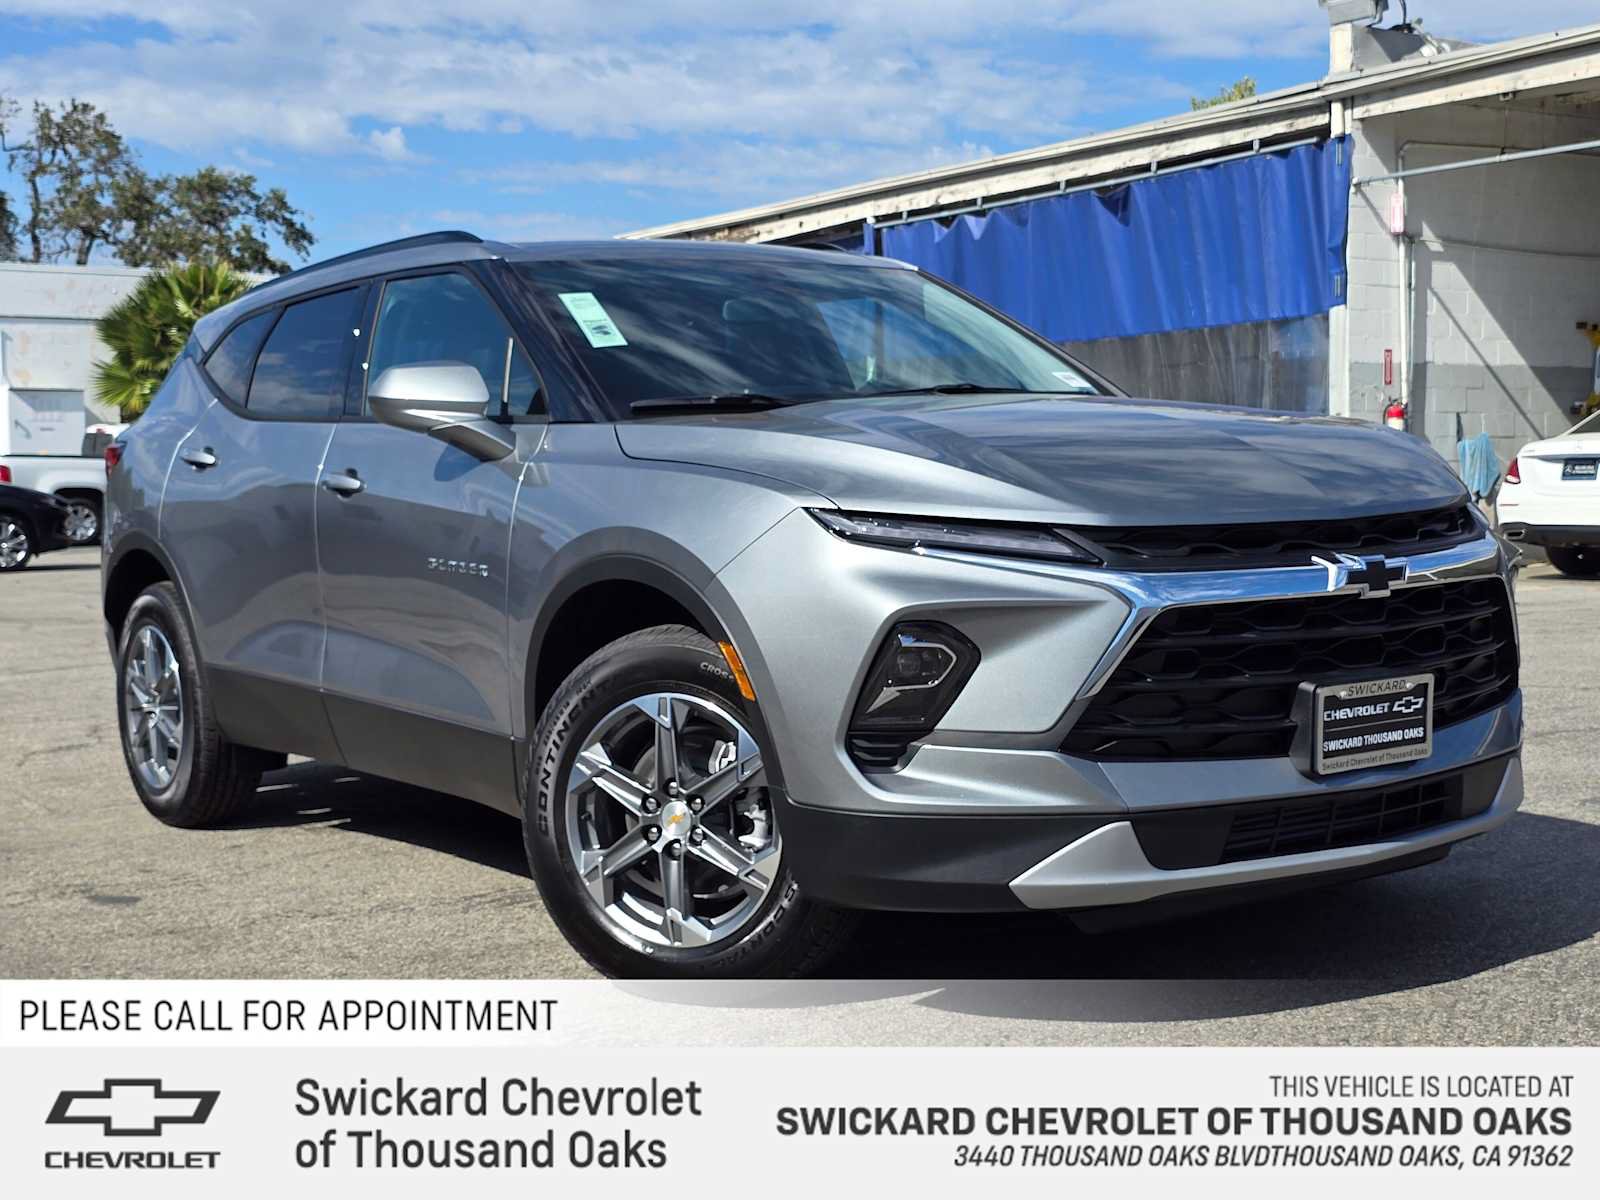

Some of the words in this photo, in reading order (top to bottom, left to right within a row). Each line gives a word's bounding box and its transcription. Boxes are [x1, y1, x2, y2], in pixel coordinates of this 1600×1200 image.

[1348, 680, 1406, 697] SWICKARD
[1323, 702, 1391, 722] CHEVROLET
[1323, 737, 1363, 752] SWICKARD
[1363, 730, 1403, 746] THOUSAND
[1404, 727, 1425, 739] OAKS
[1322, 758, 1350, 771] Swickard
